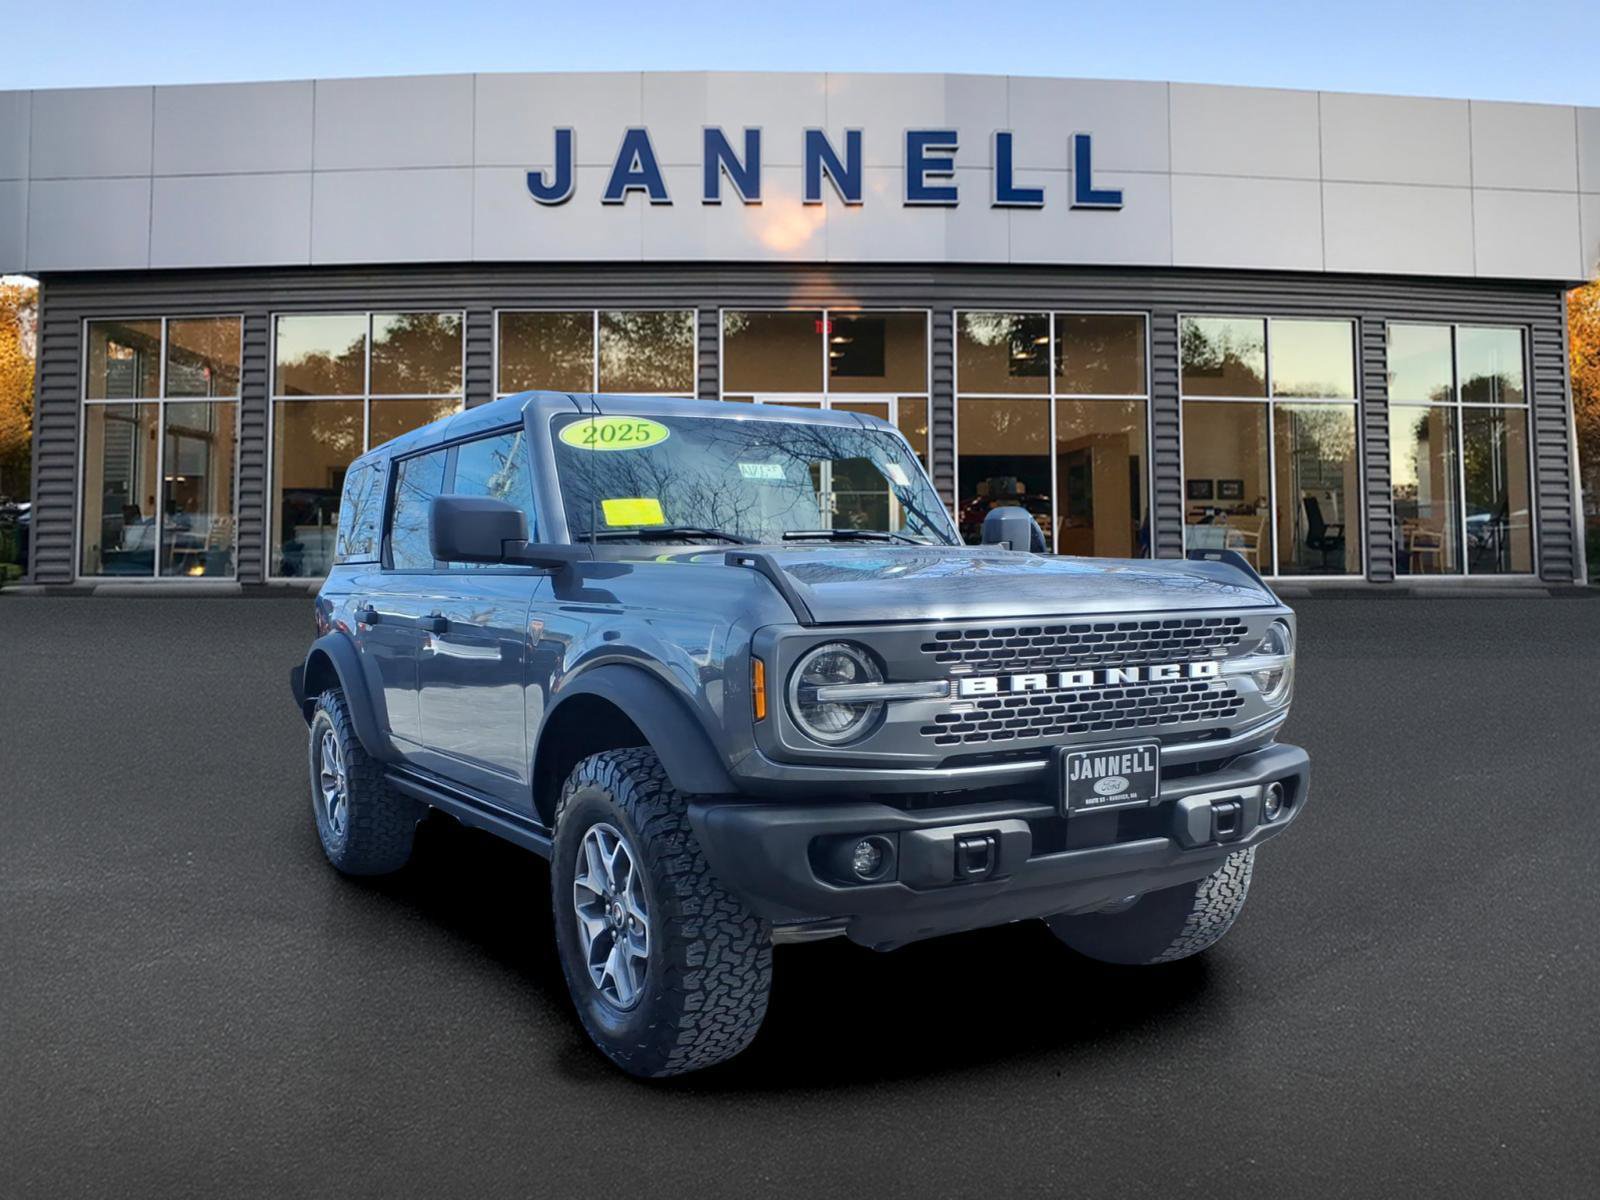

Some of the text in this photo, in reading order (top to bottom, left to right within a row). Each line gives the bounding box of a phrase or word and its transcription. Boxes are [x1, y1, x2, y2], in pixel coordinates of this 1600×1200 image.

[526, 126, 1124, 210] JANNELL
[582, 424, 650, 444] 2025
[960, 662, 1219, 695] BRONCO
[1070, 752, 1154, 780] JANNELL
